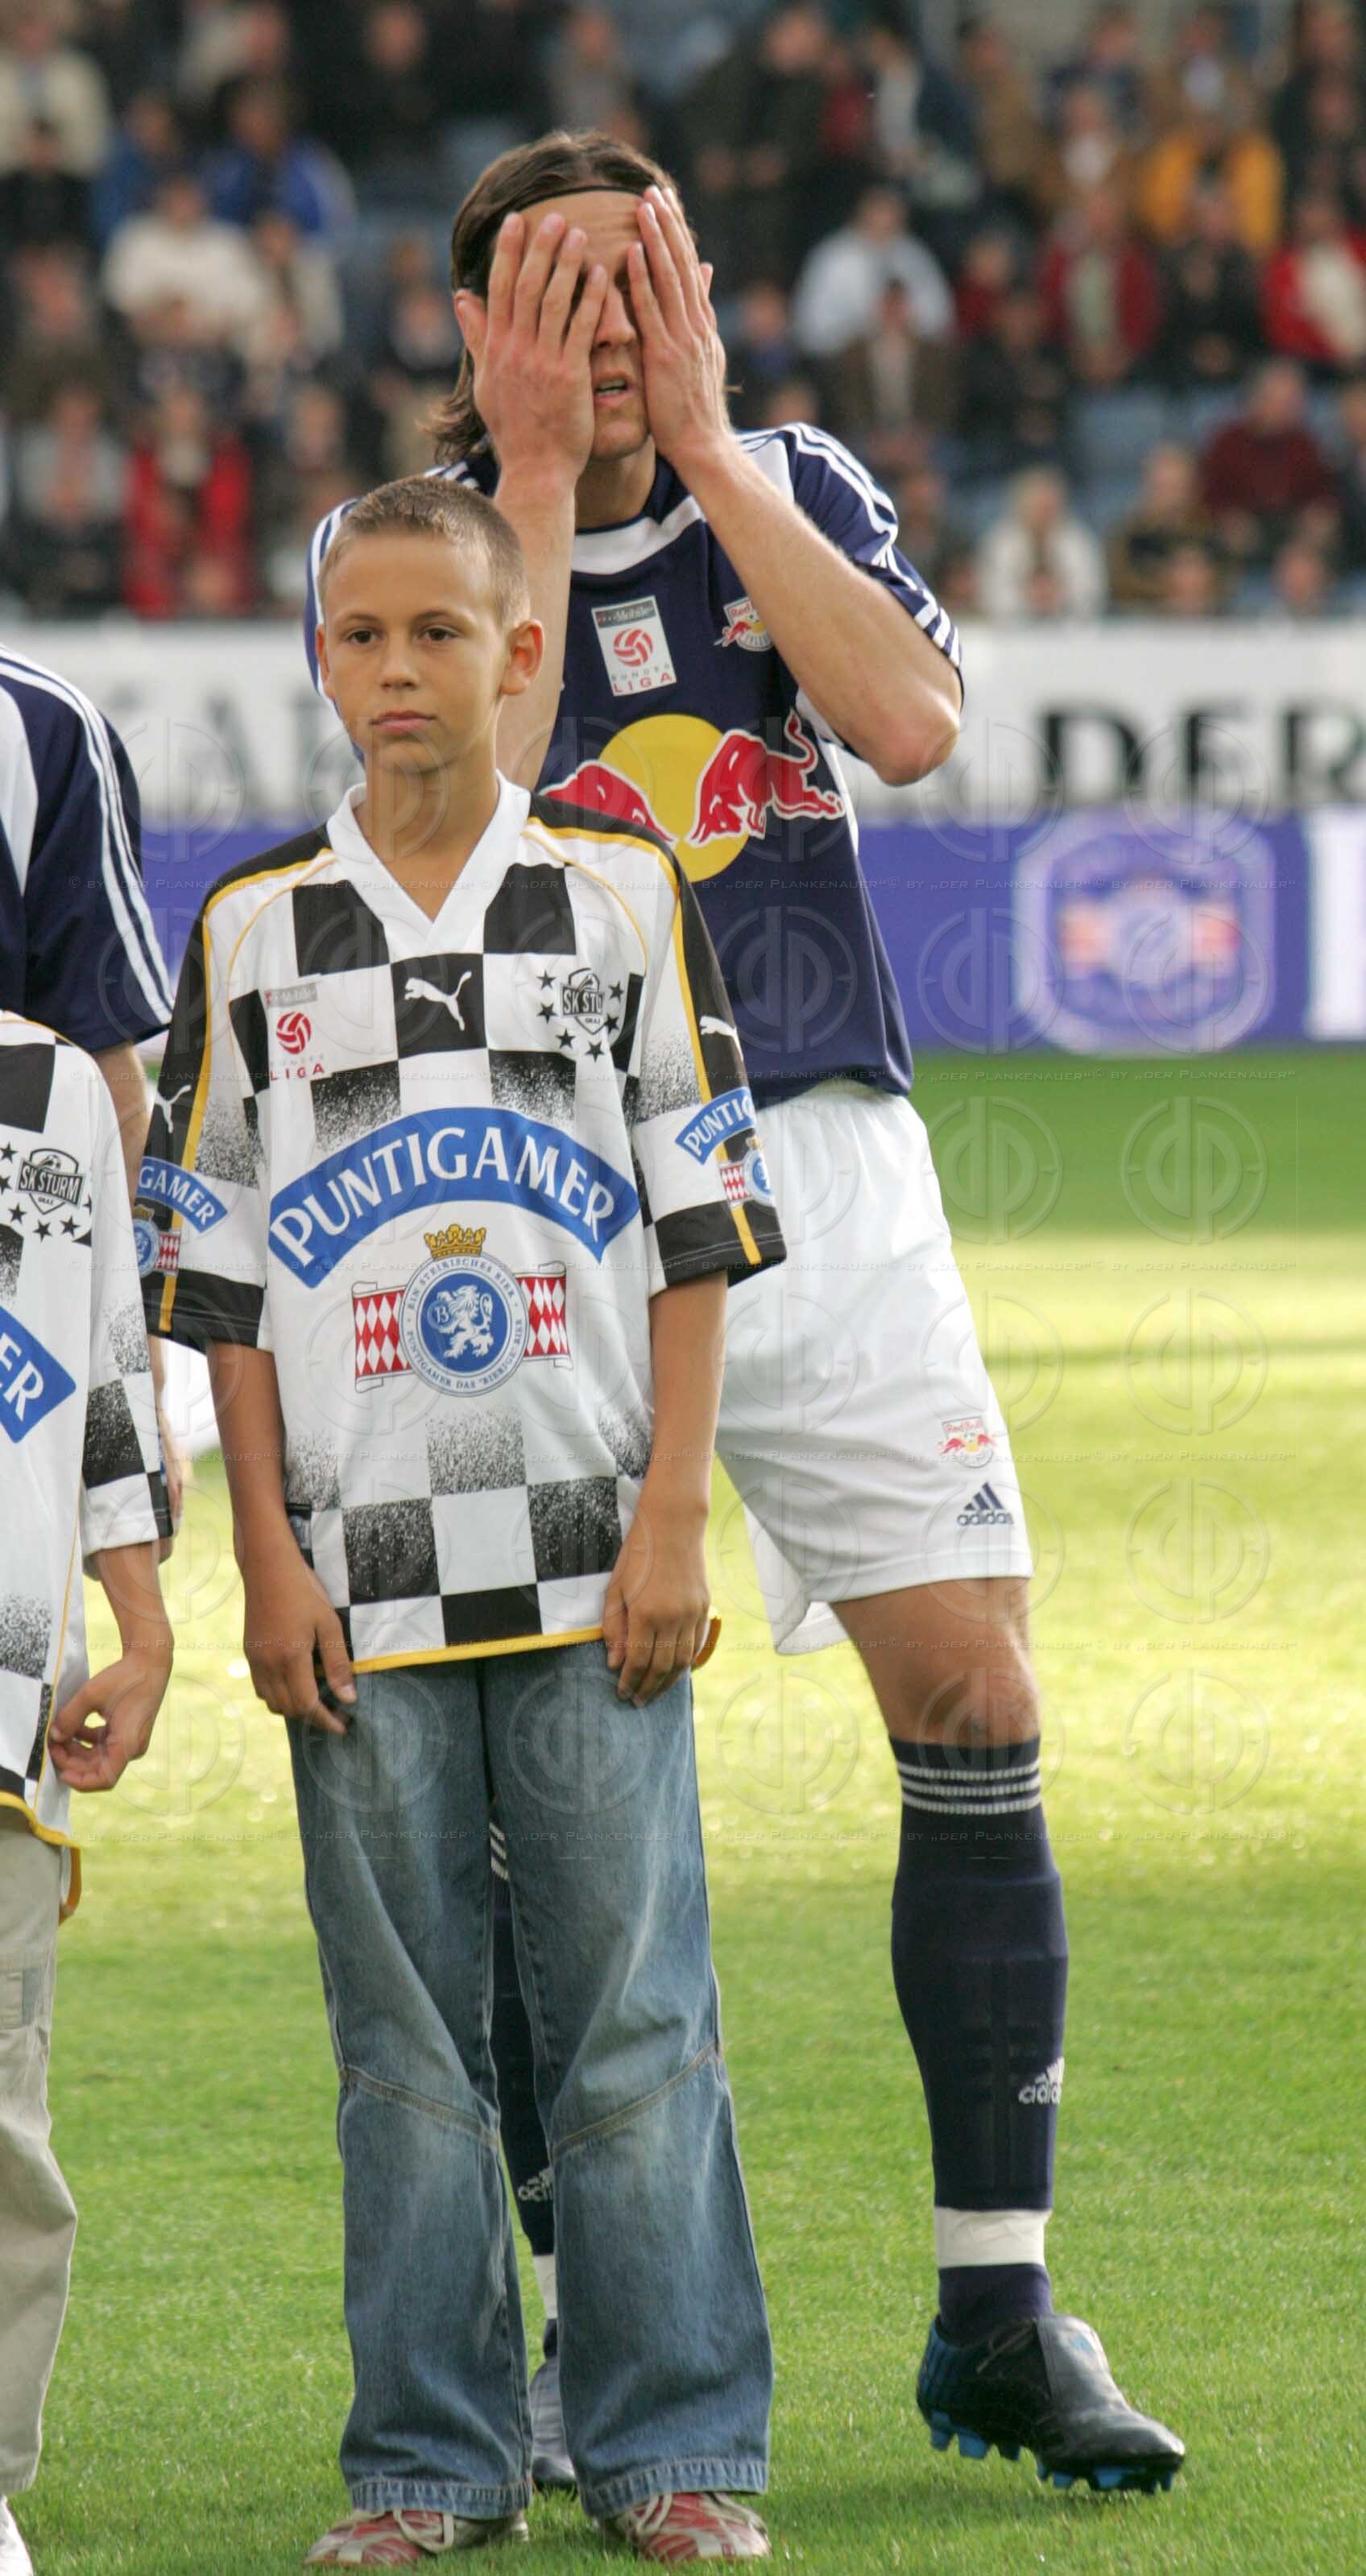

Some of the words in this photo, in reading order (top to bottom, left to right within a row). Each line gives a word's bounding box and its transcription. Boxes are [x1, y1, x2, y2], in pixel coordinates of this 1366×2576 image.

[614, 671, 672, 693] LIGA
[564, 989, 579, 1014] SK
[271, 1063, 325, 1081] LIGA
[20, 1165, 37, 1191] SK
[38, 1171, 81, 1203] STURM
[270, 1127, 615, 1267] PUNTIGAMER
